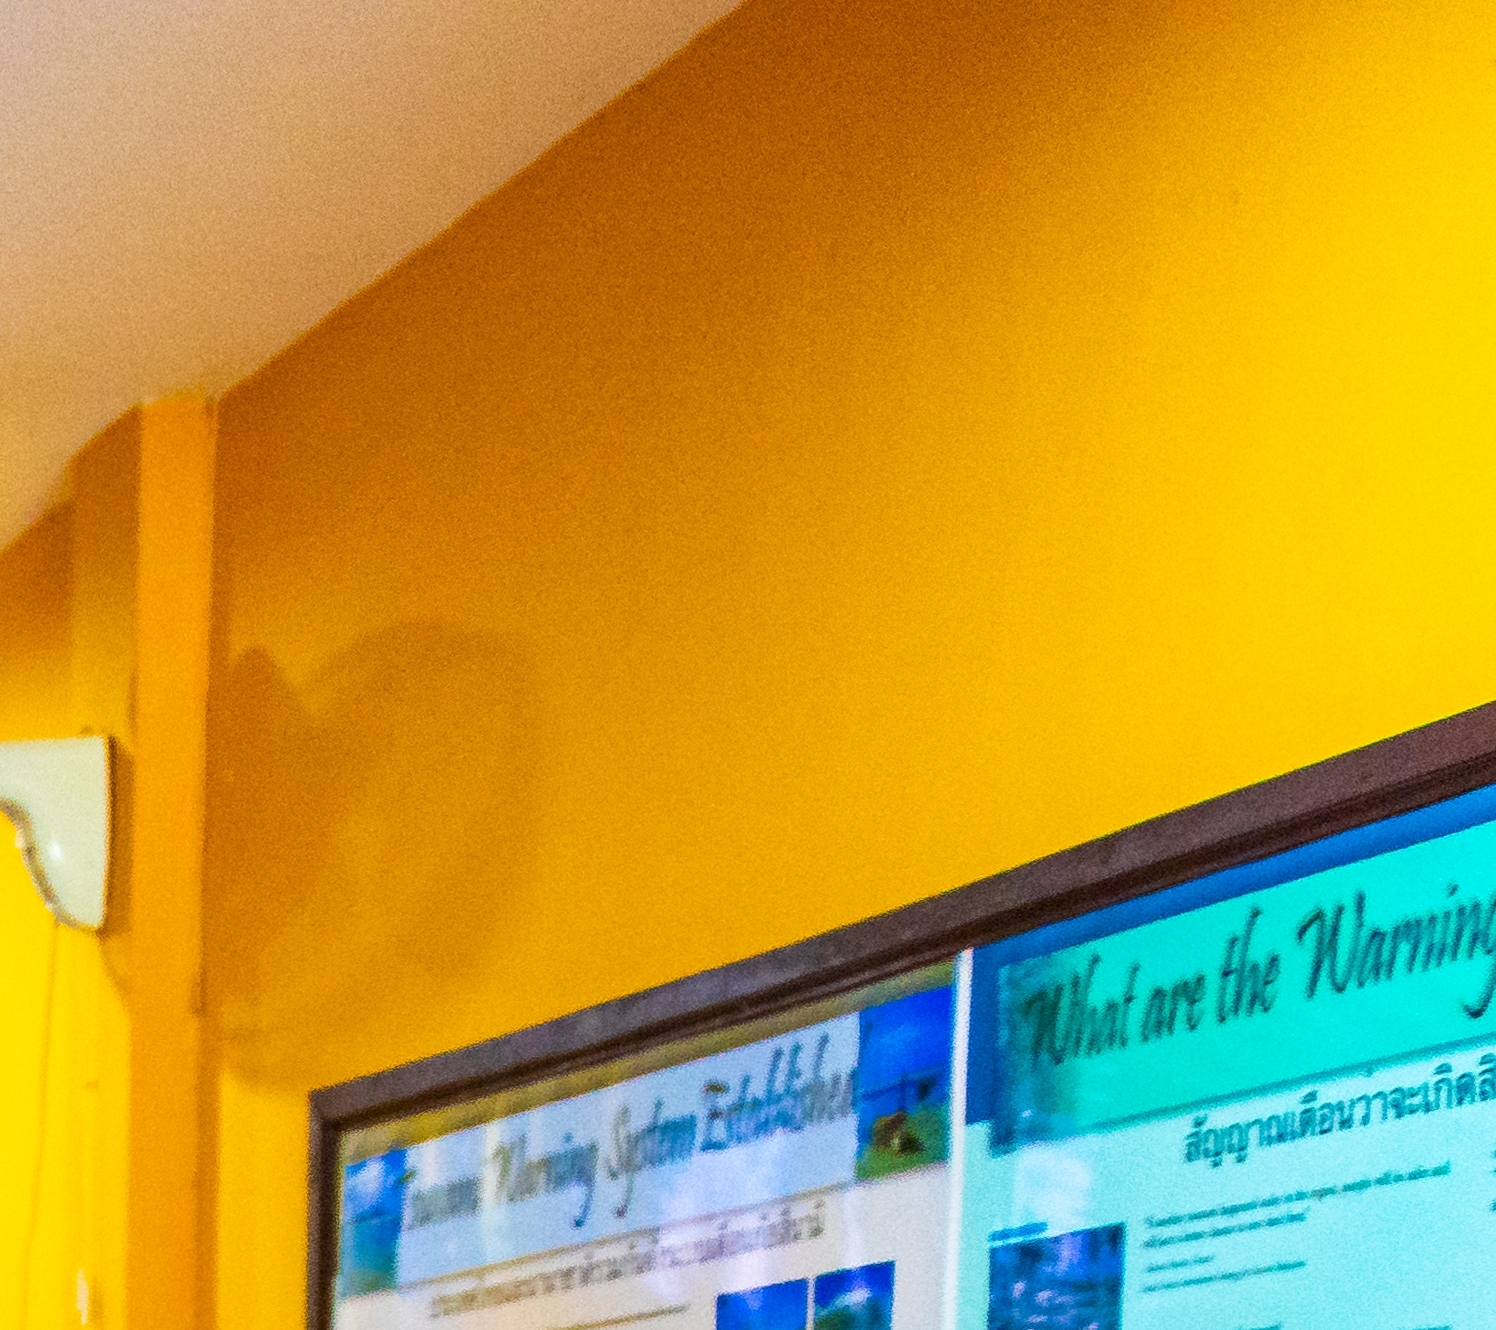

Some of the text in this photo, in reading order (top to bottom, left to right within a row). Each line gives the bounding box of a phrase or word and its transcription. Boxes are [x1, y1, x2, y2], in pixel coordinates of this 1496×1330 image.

[1020, 950, 1142, 1067] What
[1140, 970, 1208, 1044] are
[1216, 905, 1282, 1026] the
